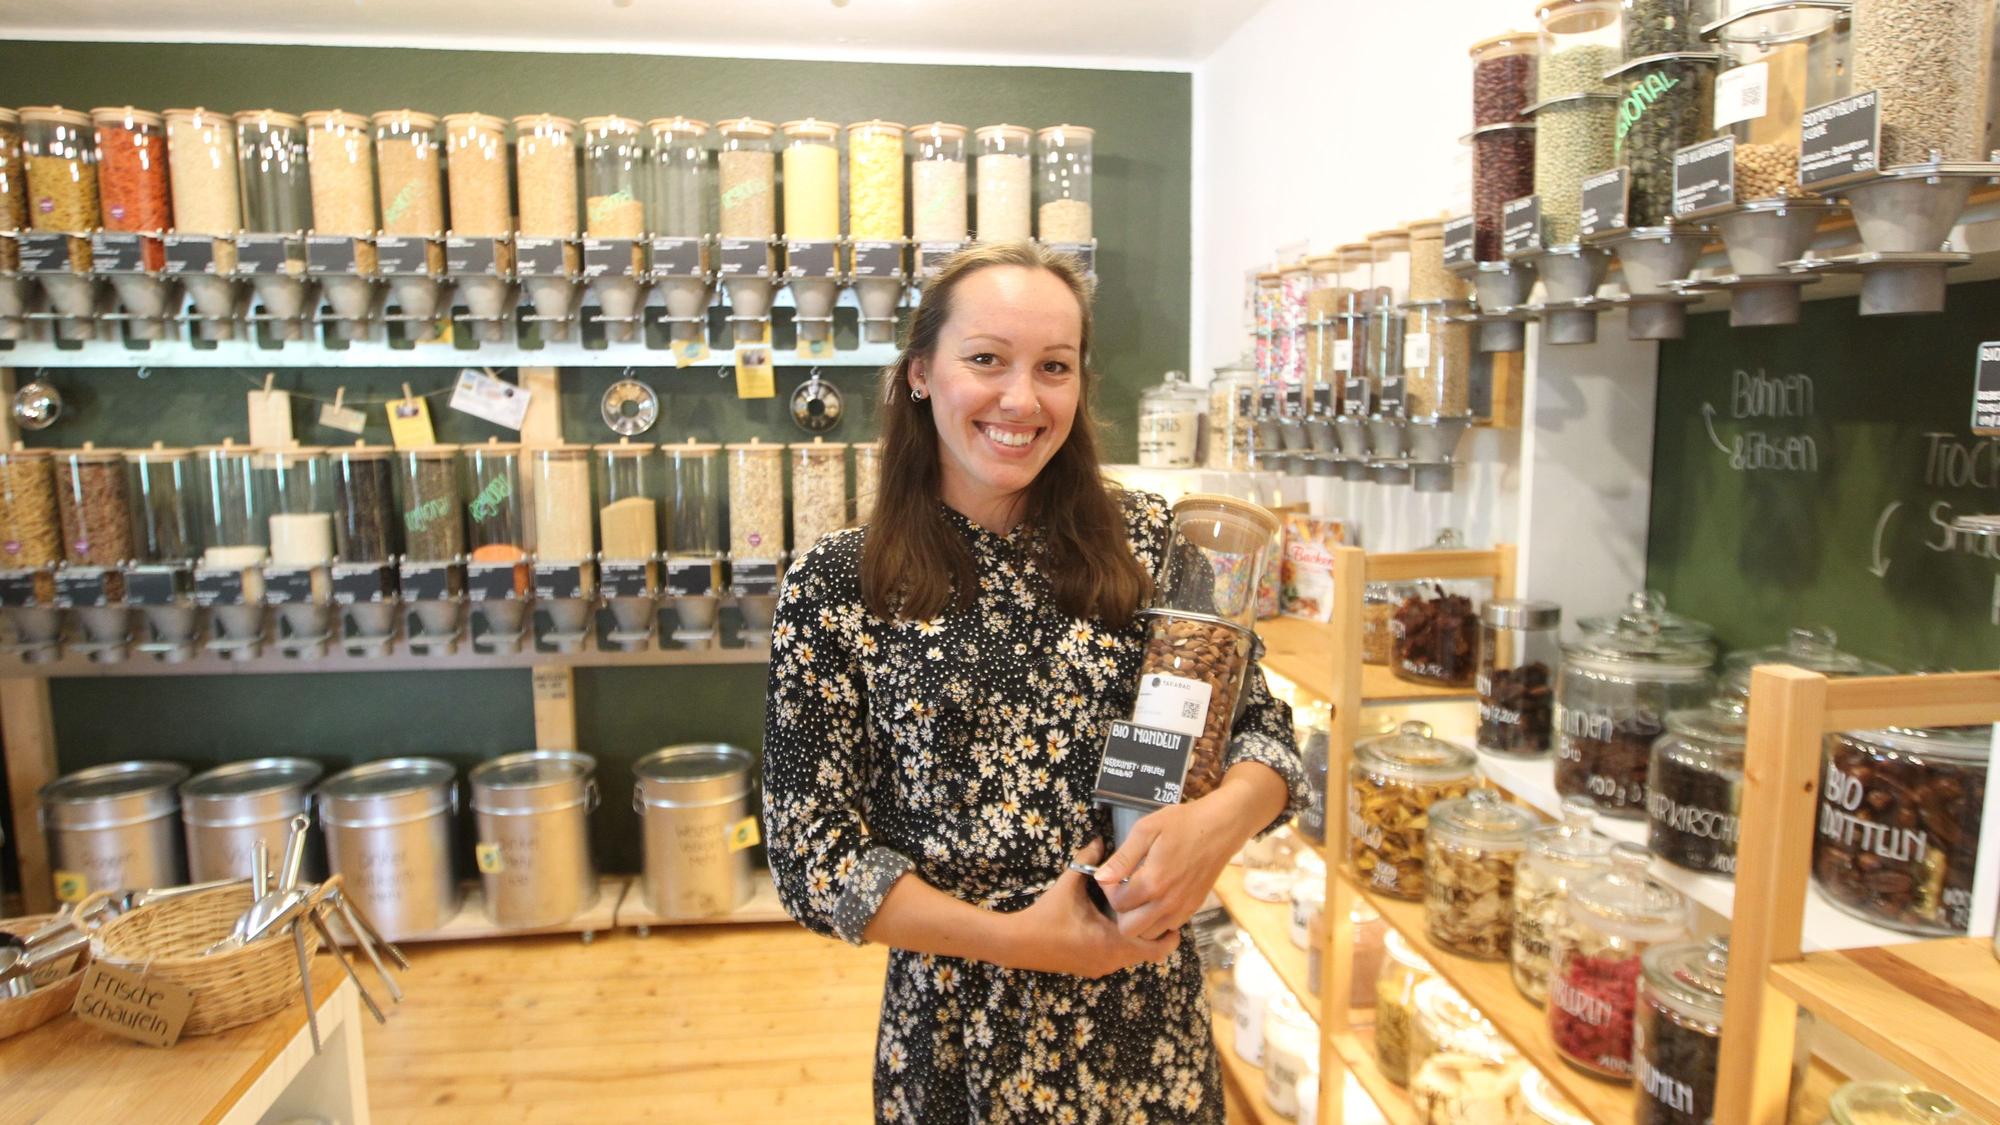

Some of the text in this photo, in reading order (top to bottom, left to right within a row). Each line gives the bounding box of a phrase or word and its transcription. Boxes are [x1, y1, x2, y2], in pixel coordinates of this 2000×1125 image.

[1111, 723, 1182, 751] BIO MANDELN
[1824, 759, 1864, 811] BIO
[93, 972, 165, 1011] Frische
[81, 993, 169, 1037] Schaufeln
